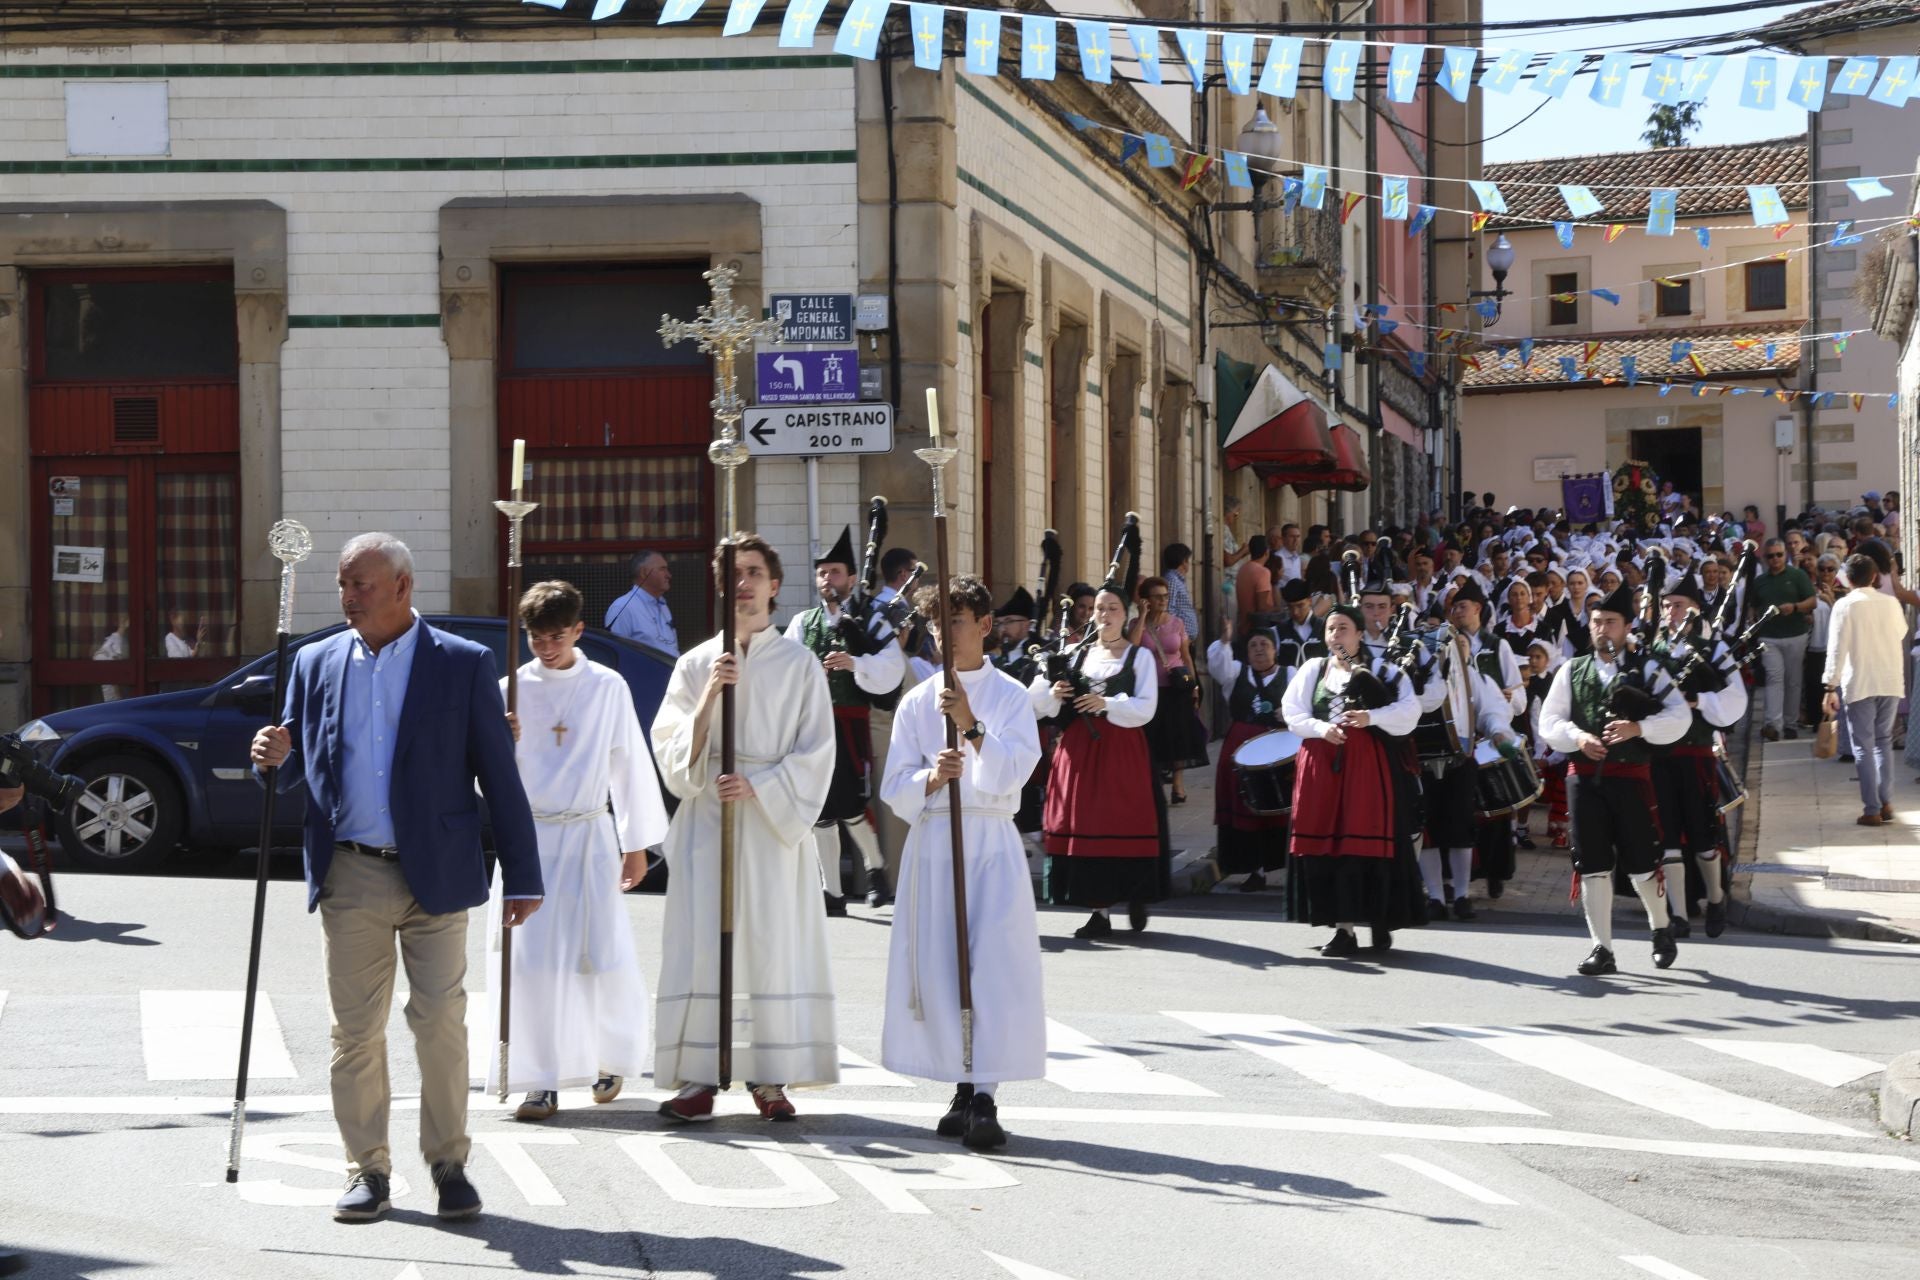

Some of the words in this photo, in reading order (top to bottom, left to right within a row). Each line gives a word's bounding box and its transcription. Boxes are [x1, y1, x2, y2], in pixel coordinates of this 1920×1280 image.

[800, 297, 834, 309] CALLE
[797, 312, 841, 324] GENERAL
[783, 326, 846, 340] AMPOMANES
[785, 411, 886, 428] CAPISTRANO
[809, 435, 842, 447] 200
[851, 435, 863, 446] m
[223, 1130, 1022, 1214] STOP
